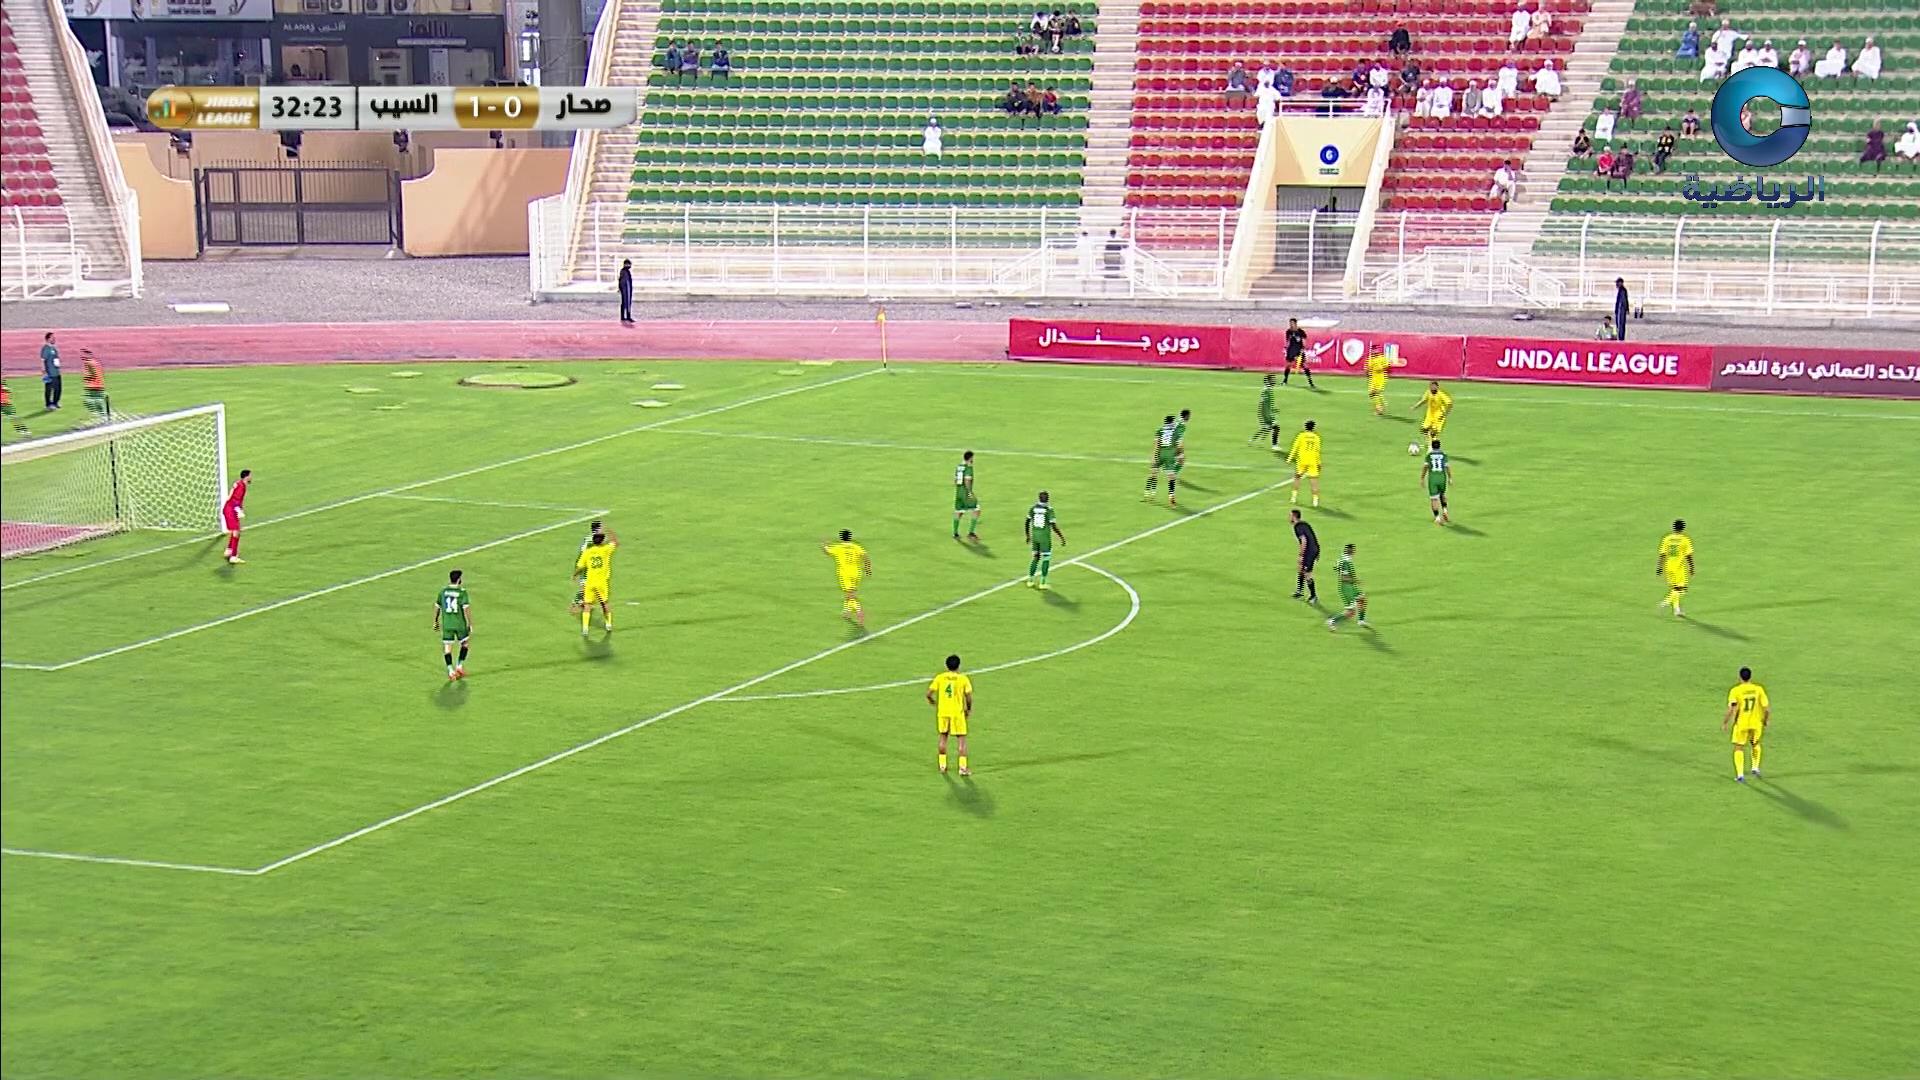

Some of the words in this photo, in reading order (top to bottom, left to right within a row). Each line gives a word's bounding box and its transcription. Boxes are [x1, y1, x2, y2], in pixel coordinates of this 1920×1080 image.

[1156, 336, 1201, 356] دوري
[1497, 348, 1582, 372] JINDAL
[1586, 351, 1679, 375] LEAGUE
[1720, 358, 1768, 376] القدم
[1770, 360, 1805, 380] لكرة
[1807, 361, 1875, 380] العماني
[445, 598, 458, 612] 14
[945, 684, 953, 698] 4
[1744, 698, 1755, 712] 17
